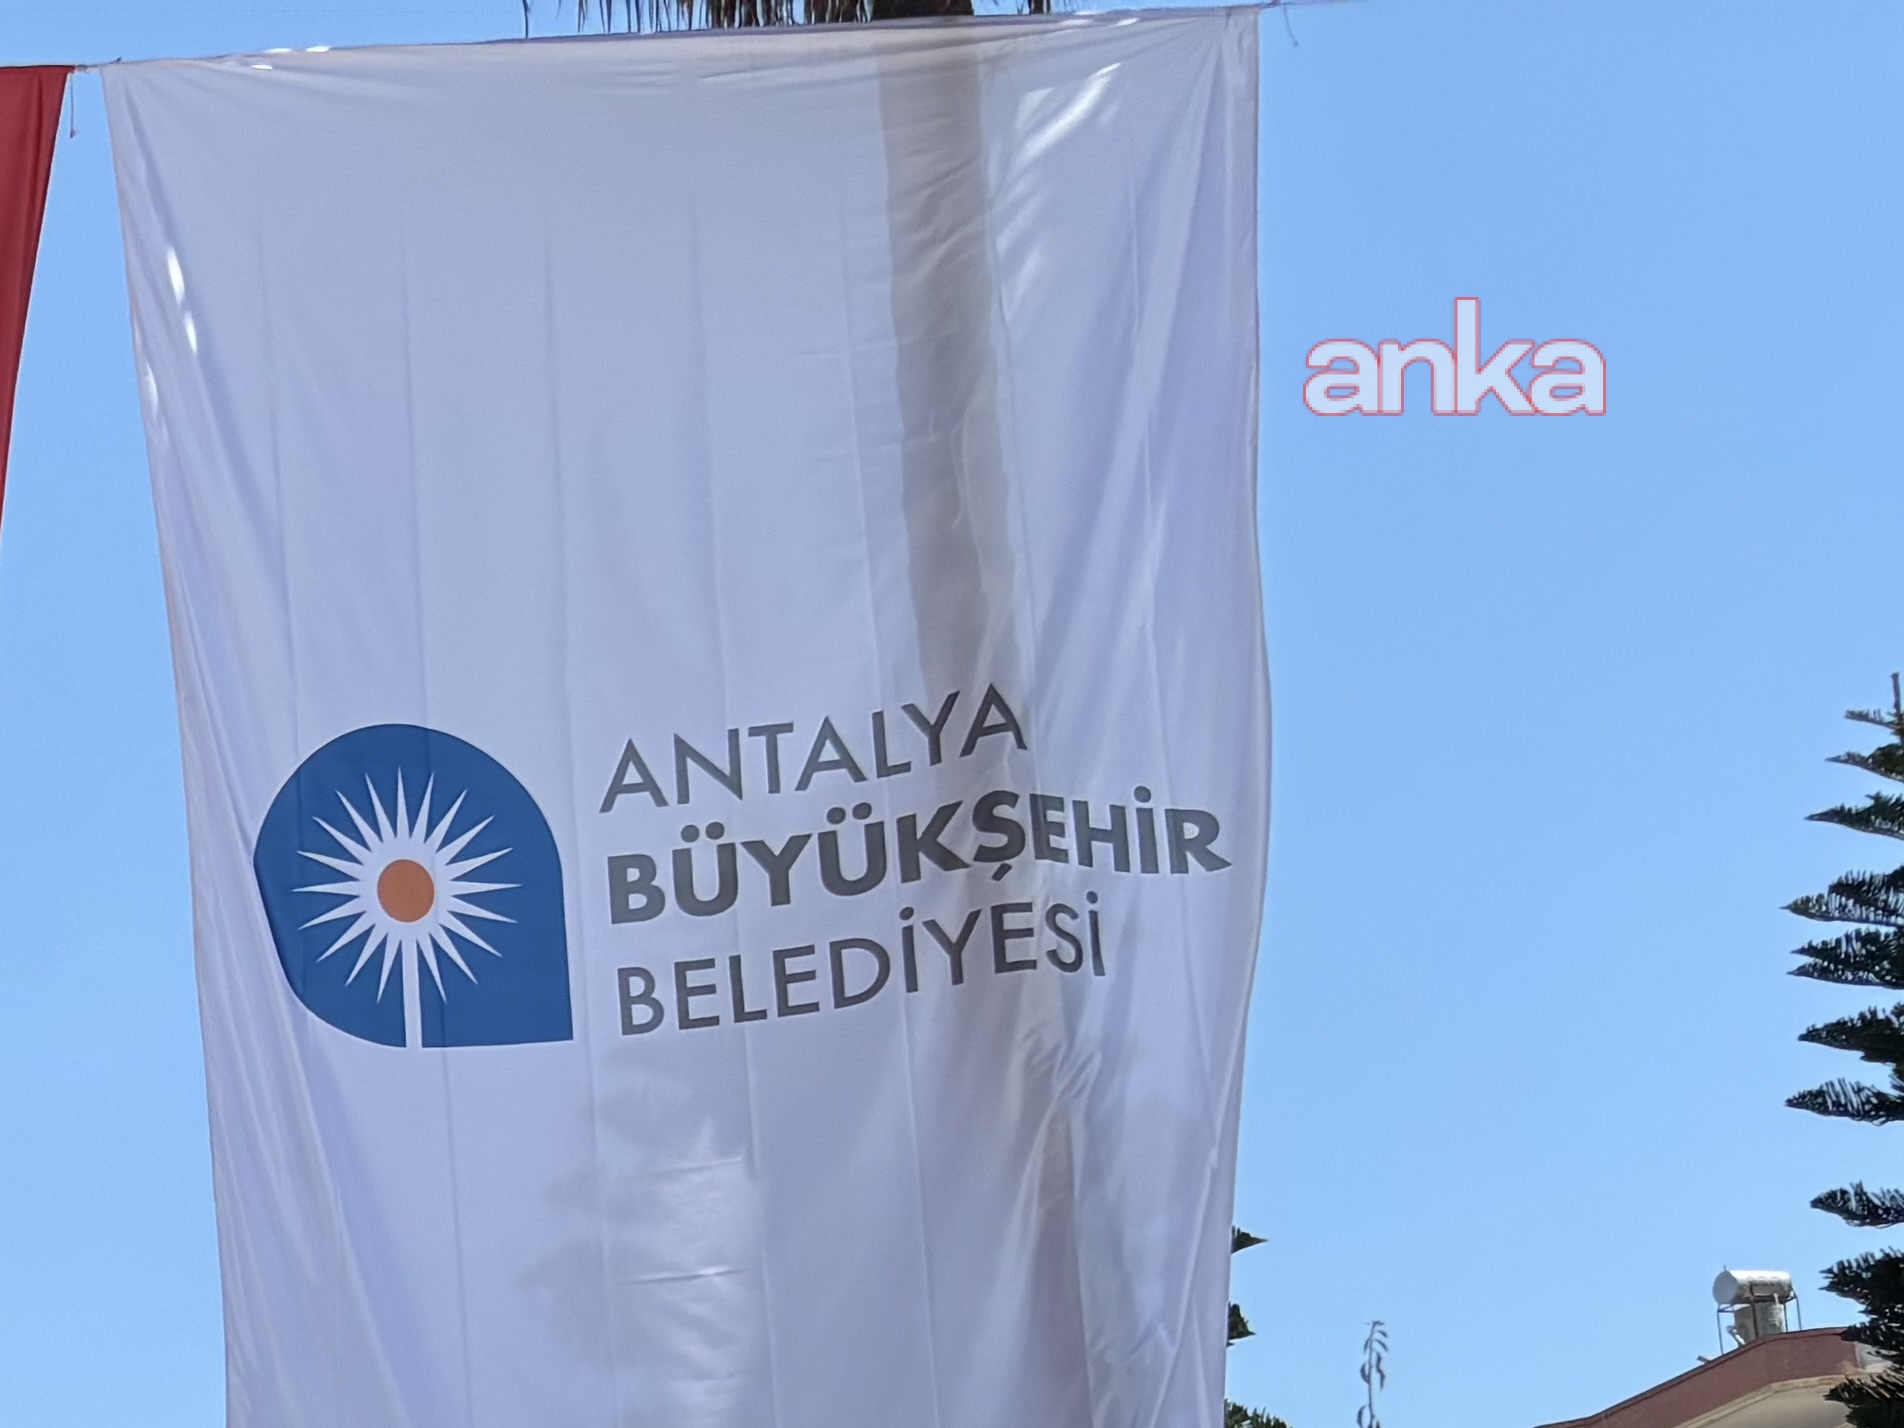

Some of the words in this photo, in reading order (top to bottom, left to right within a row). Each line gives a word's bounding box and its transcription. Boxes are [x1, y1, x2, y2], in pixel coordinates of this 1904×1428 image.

[599, 682, 1028, 813] ANTALYA
[608, 785, 1233, 926] BÜYÜKŞEHİR
[617, 890, 1105, 1038] BELEDİYESİ
